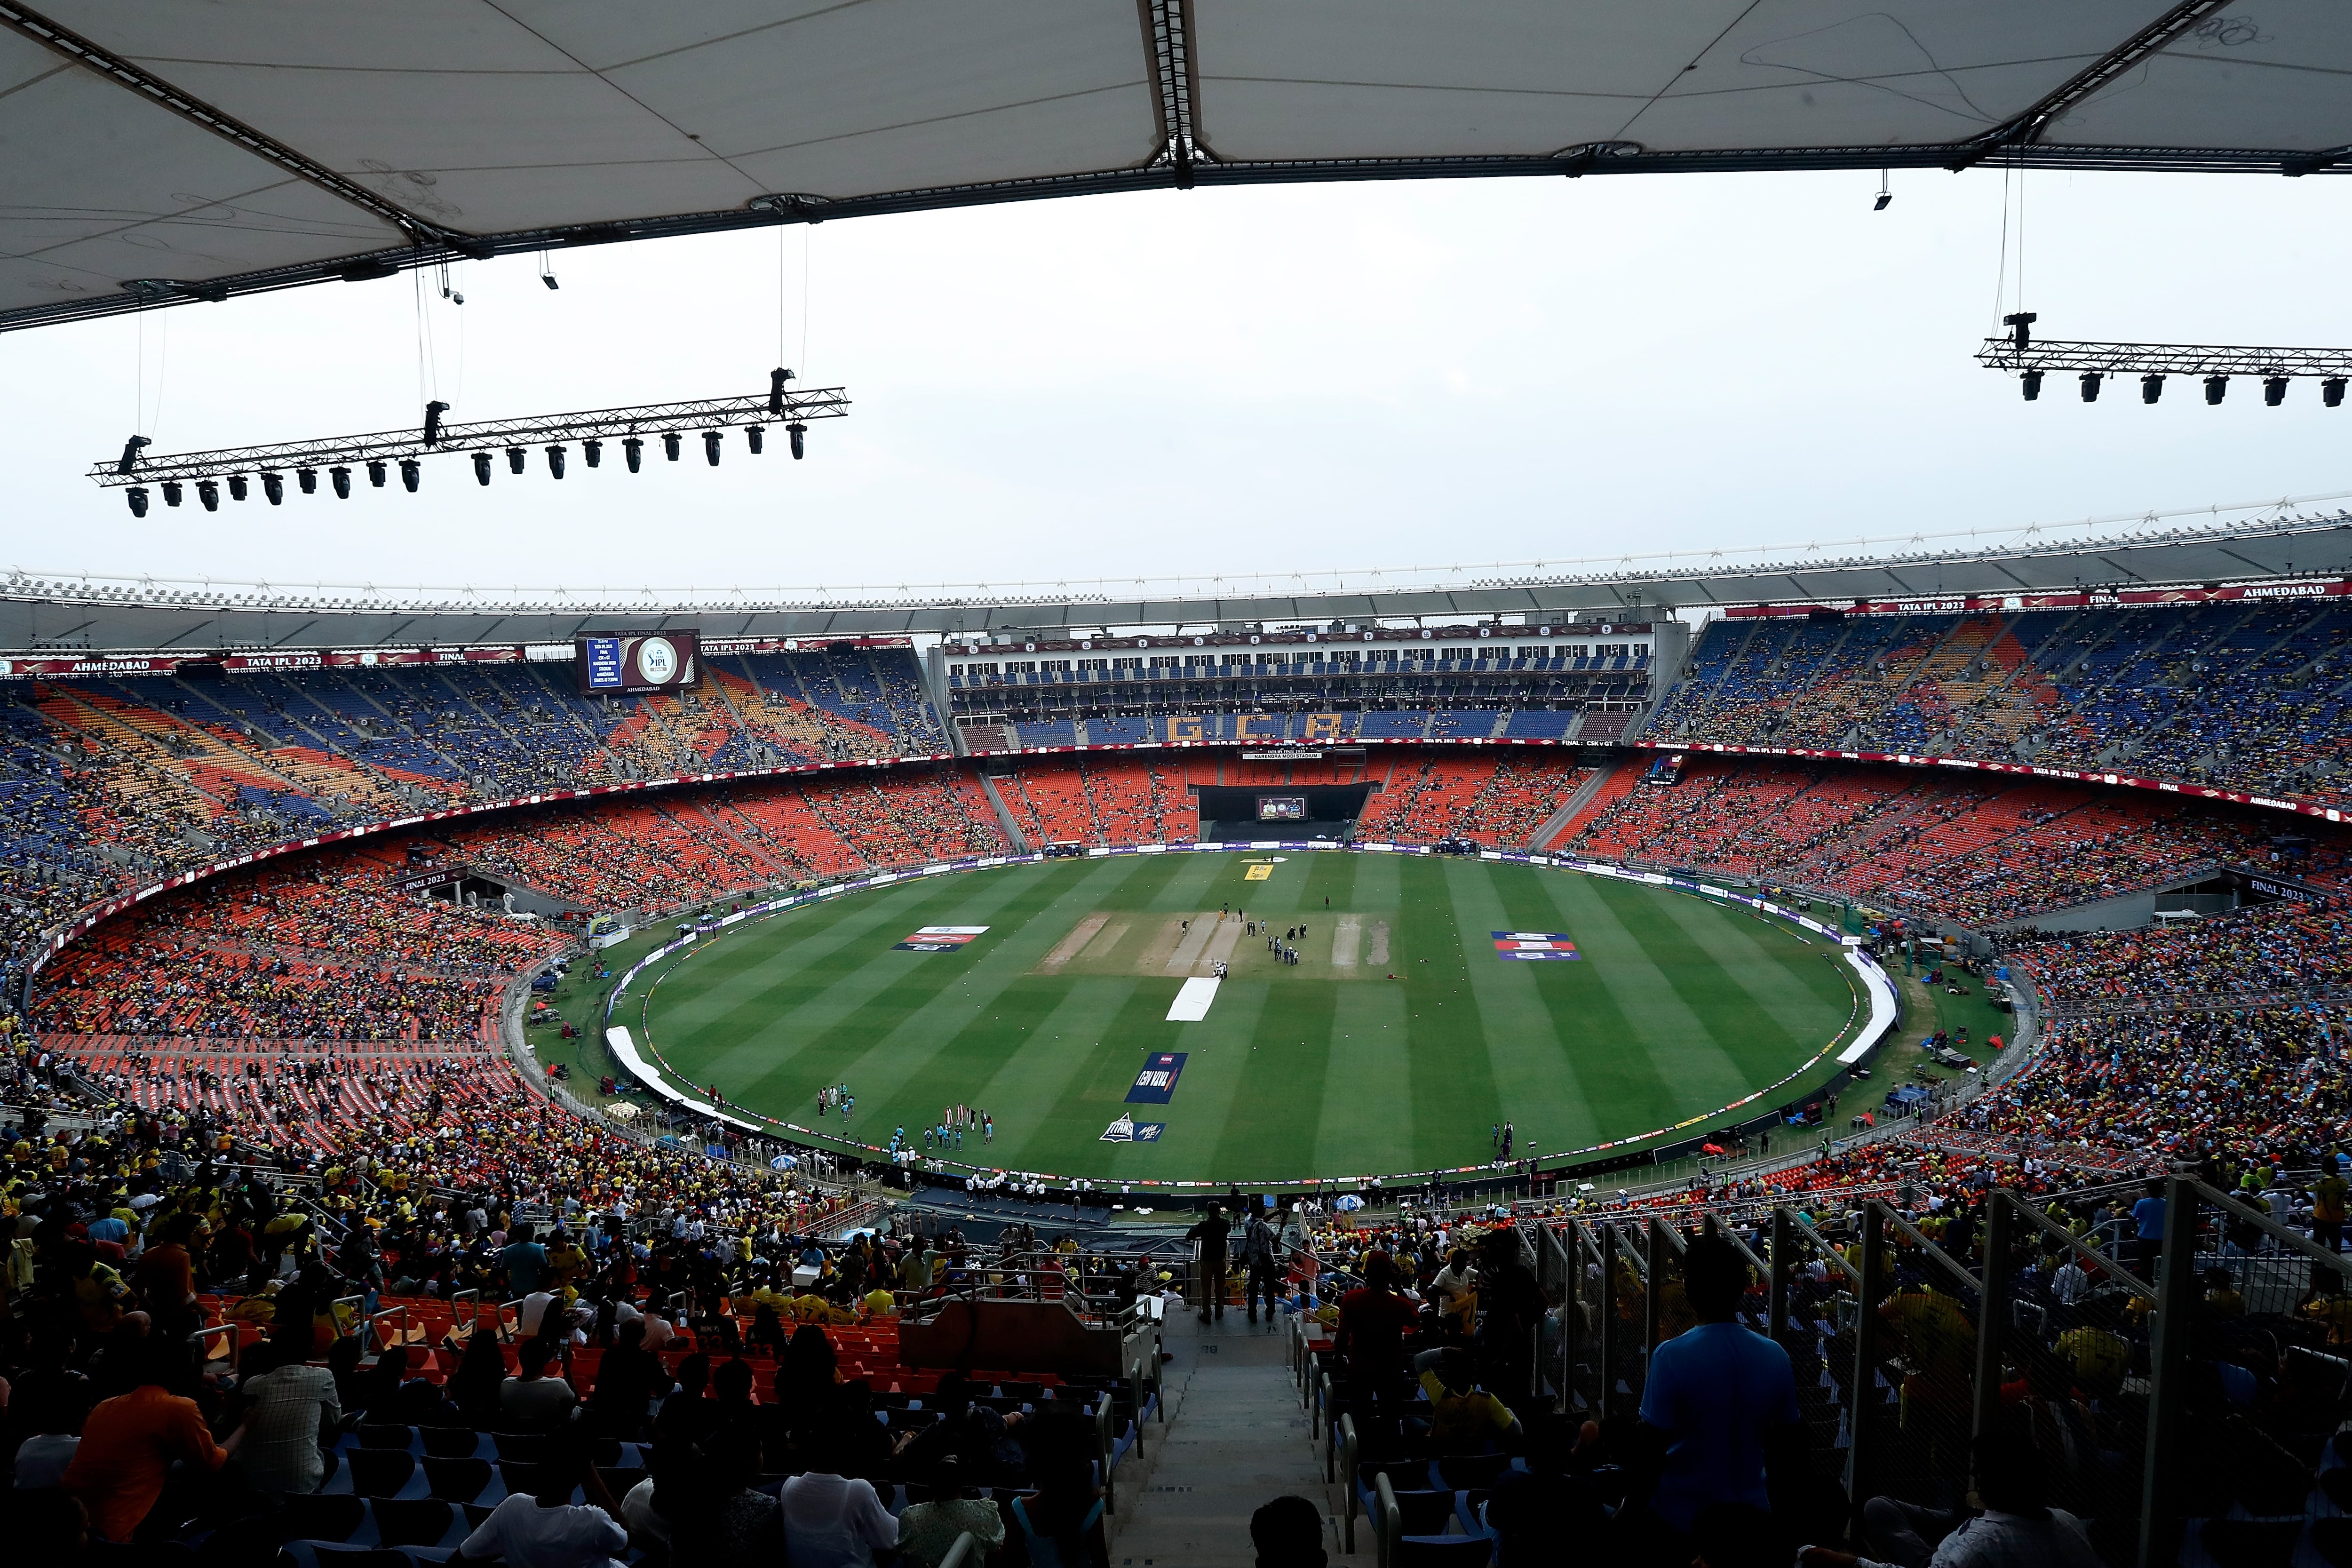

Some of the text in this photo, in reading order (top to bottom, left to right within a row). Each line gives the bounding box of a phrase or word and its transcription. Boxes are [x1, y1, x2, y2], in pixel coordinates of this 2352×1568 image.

[2243, 586, 2325, 597] AHMEDABAD
[72, 660, 150, 672] AHMEDABAD
[246, 657, 322, 668] TATA IPL 2023
[1937, 759, 1979, 768] AHMEDABAD
[2062, 771, 2080, 779] 2023
[645, 778, 679, 787] AHMEDABAD
[2159, 783, 2179, 792] FINAL
[2250, 797, 2297, 810] AHMEDABAD
[389, 815, 425, 828] AHMEDABAD
[303, 837, 319, 847] FINAL
[214, 855, 253, 872] TATA IPL 2023
[406, 874, 445, 891] FINAL 2023
[2251, 880, 2279, 895] FINAL
[135, 883, 164, 901] AHMEDABAD
[1106, 1122, 1134, 1136] TITANS
[697, 1334, 723, 1352] 33
